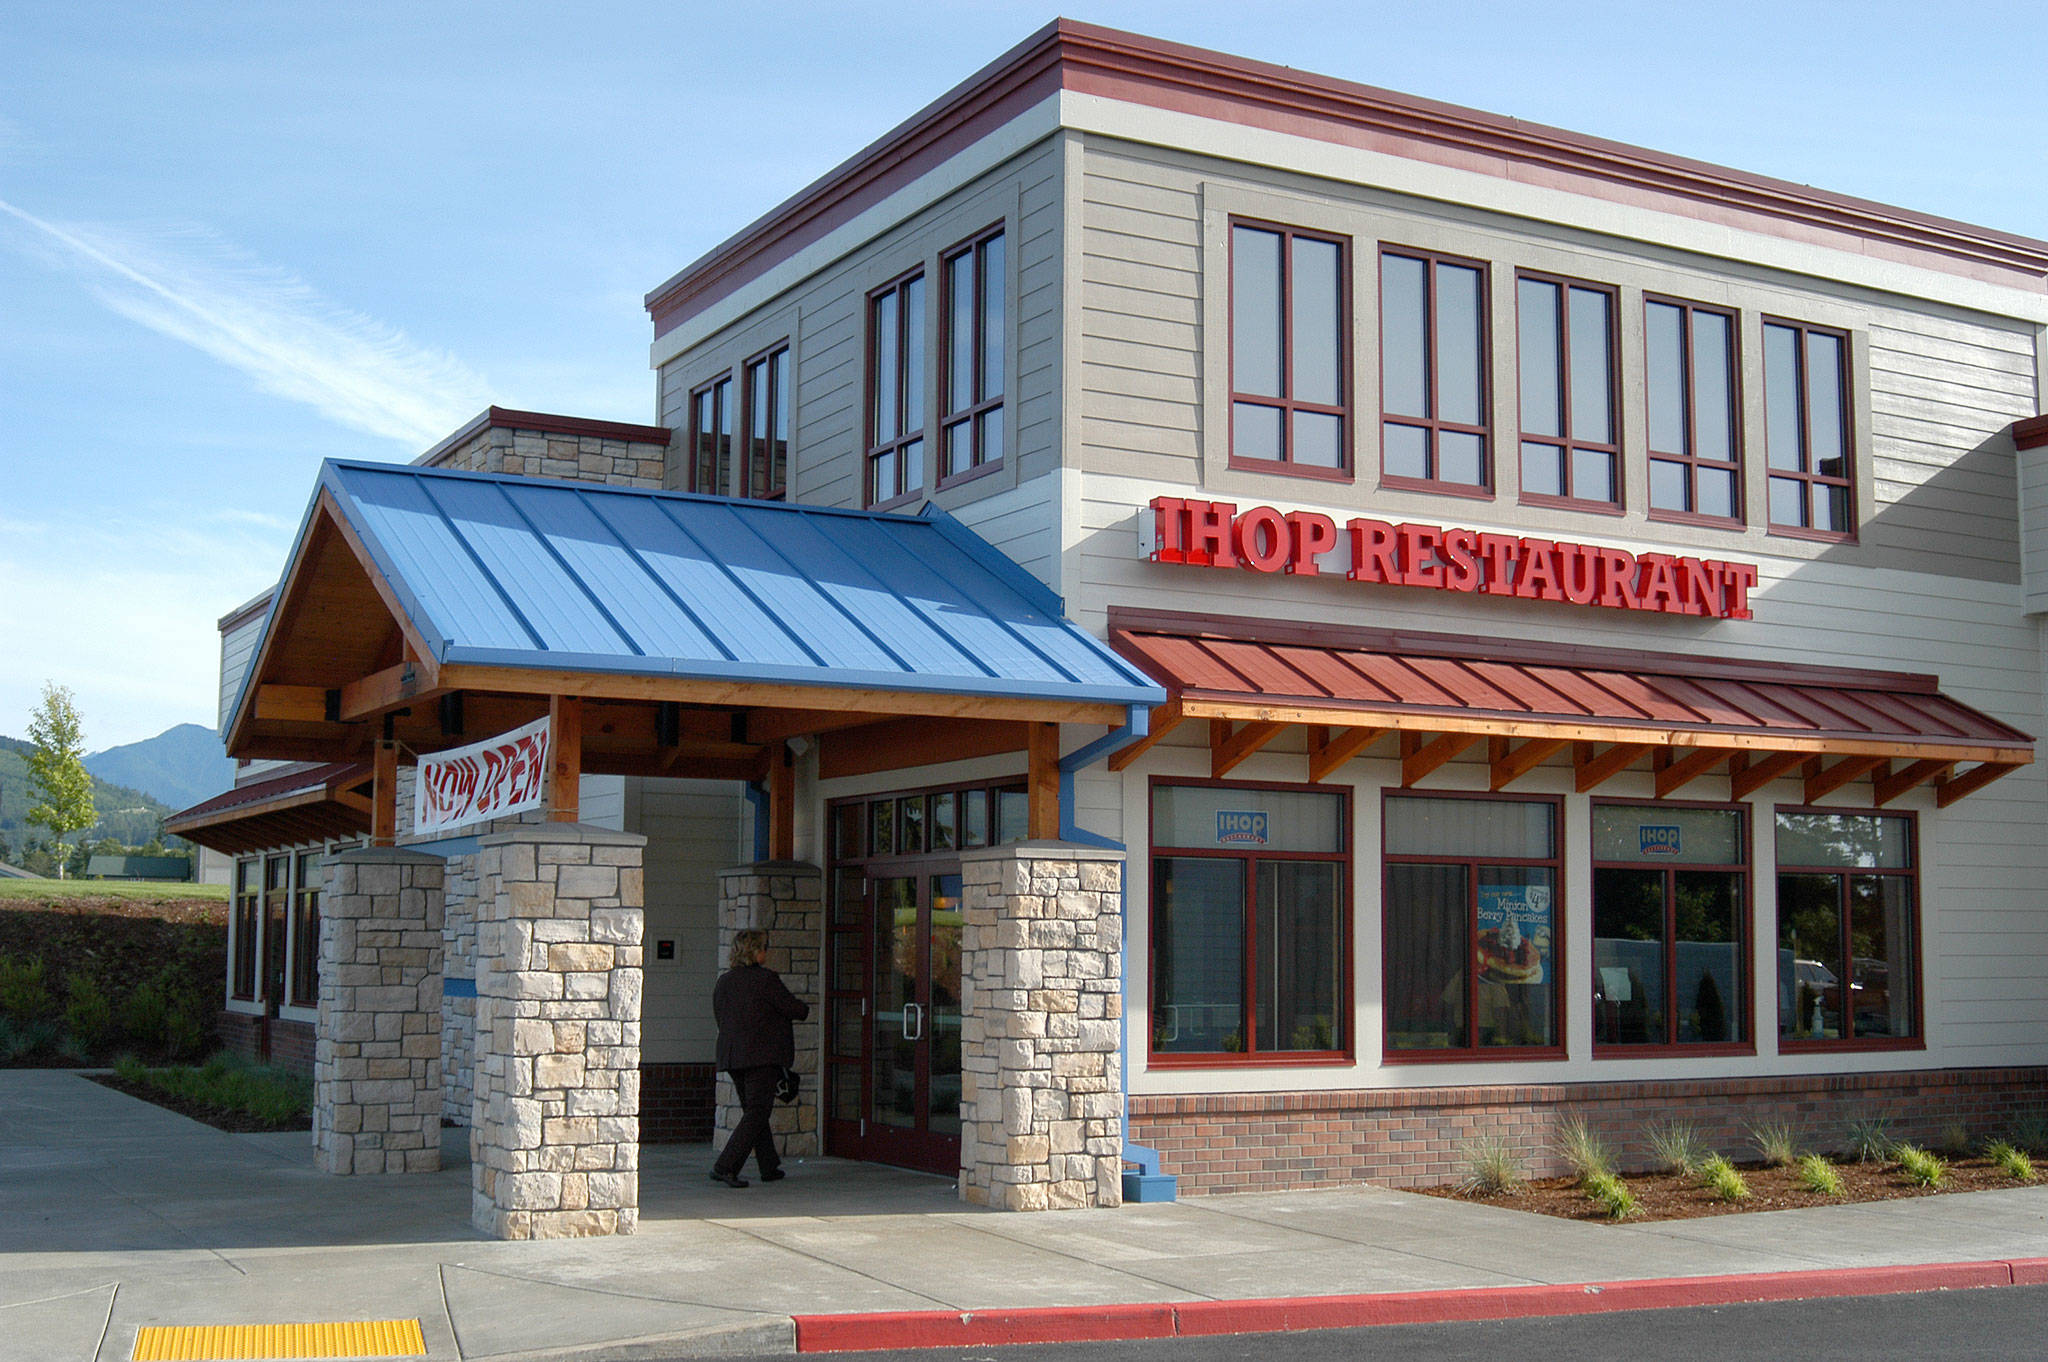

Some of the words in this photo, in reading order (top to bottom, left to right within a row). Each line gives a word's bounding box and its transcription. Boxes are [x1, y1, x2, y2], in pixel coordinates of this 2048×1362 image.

[1150, 496, 1337, 575] IHOP
[1347, 517, 1758, 620] RESTAURANT
[422, 756, 480, 824] NOW
[477, 729, 547, 814] OPEN
[1219, 813, 1265, 836] IHOP
[1641, 828, 1678, 847] IHOP
